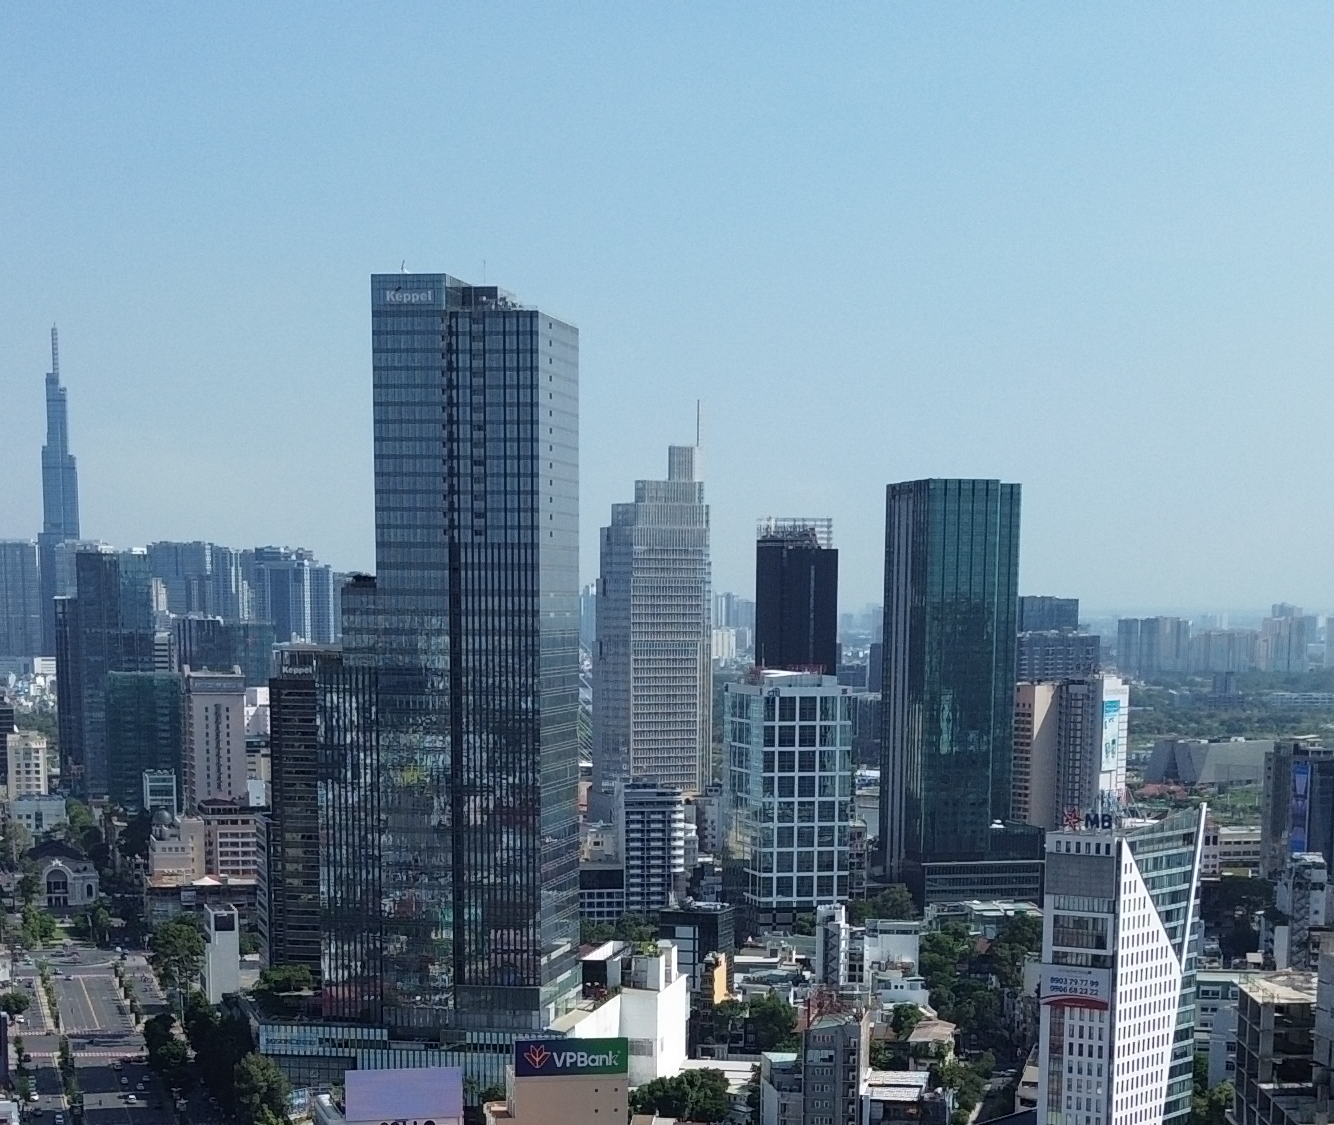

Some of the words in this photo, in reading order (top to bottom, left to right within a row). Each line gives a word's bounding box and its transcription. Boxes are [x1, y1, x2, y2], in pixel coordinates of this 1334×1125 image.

[386, 290, 432, 303] Keppel
[282, 665, 312, 674] Keppel
[1084, 813, 1112, 829] MB
[553, 1051, 619, 1068] VPBank
